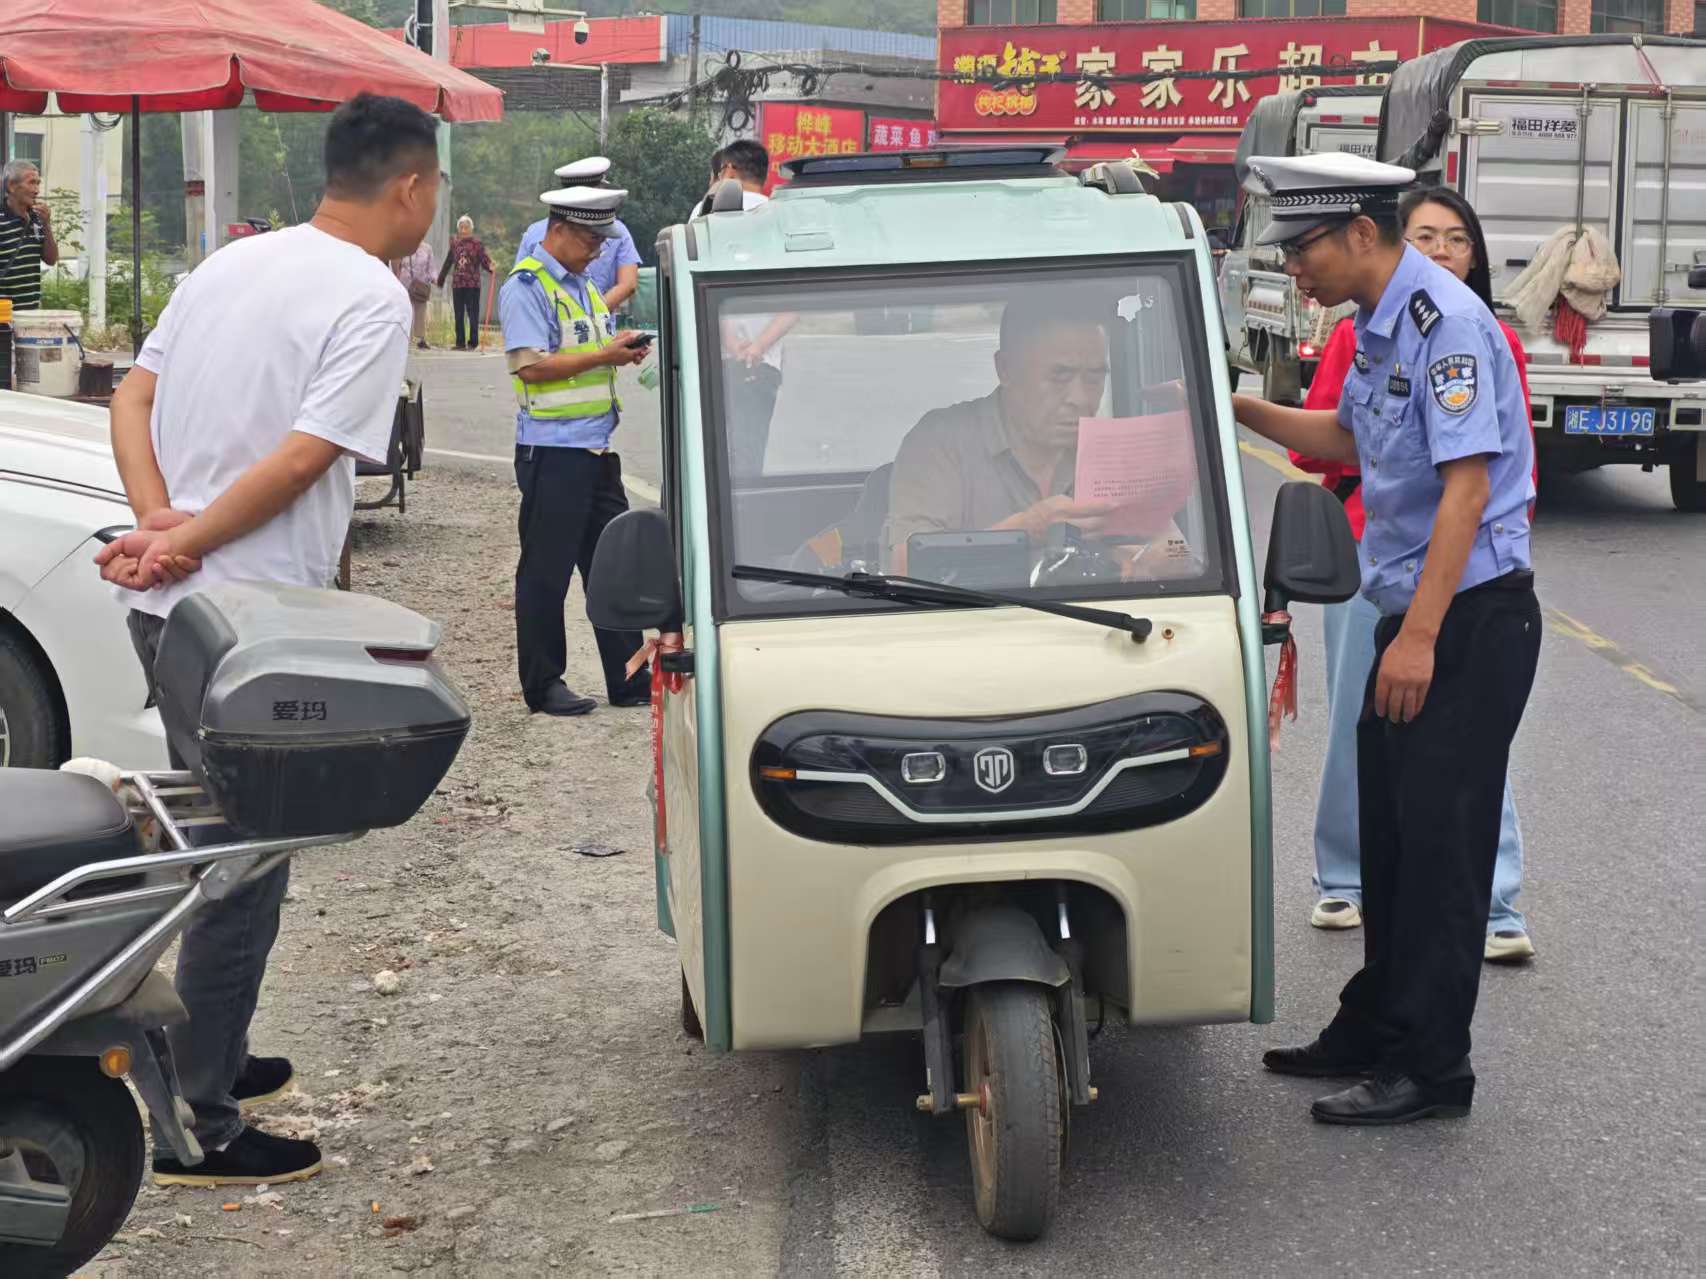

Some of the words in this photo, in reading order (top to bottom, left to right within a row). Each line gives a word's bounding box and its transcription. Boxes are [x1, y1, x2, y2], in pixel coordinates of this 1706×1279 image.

[1511, 119, 1577, 132] 福田祥菱
[273, 700, 327, 721] 爱玛
